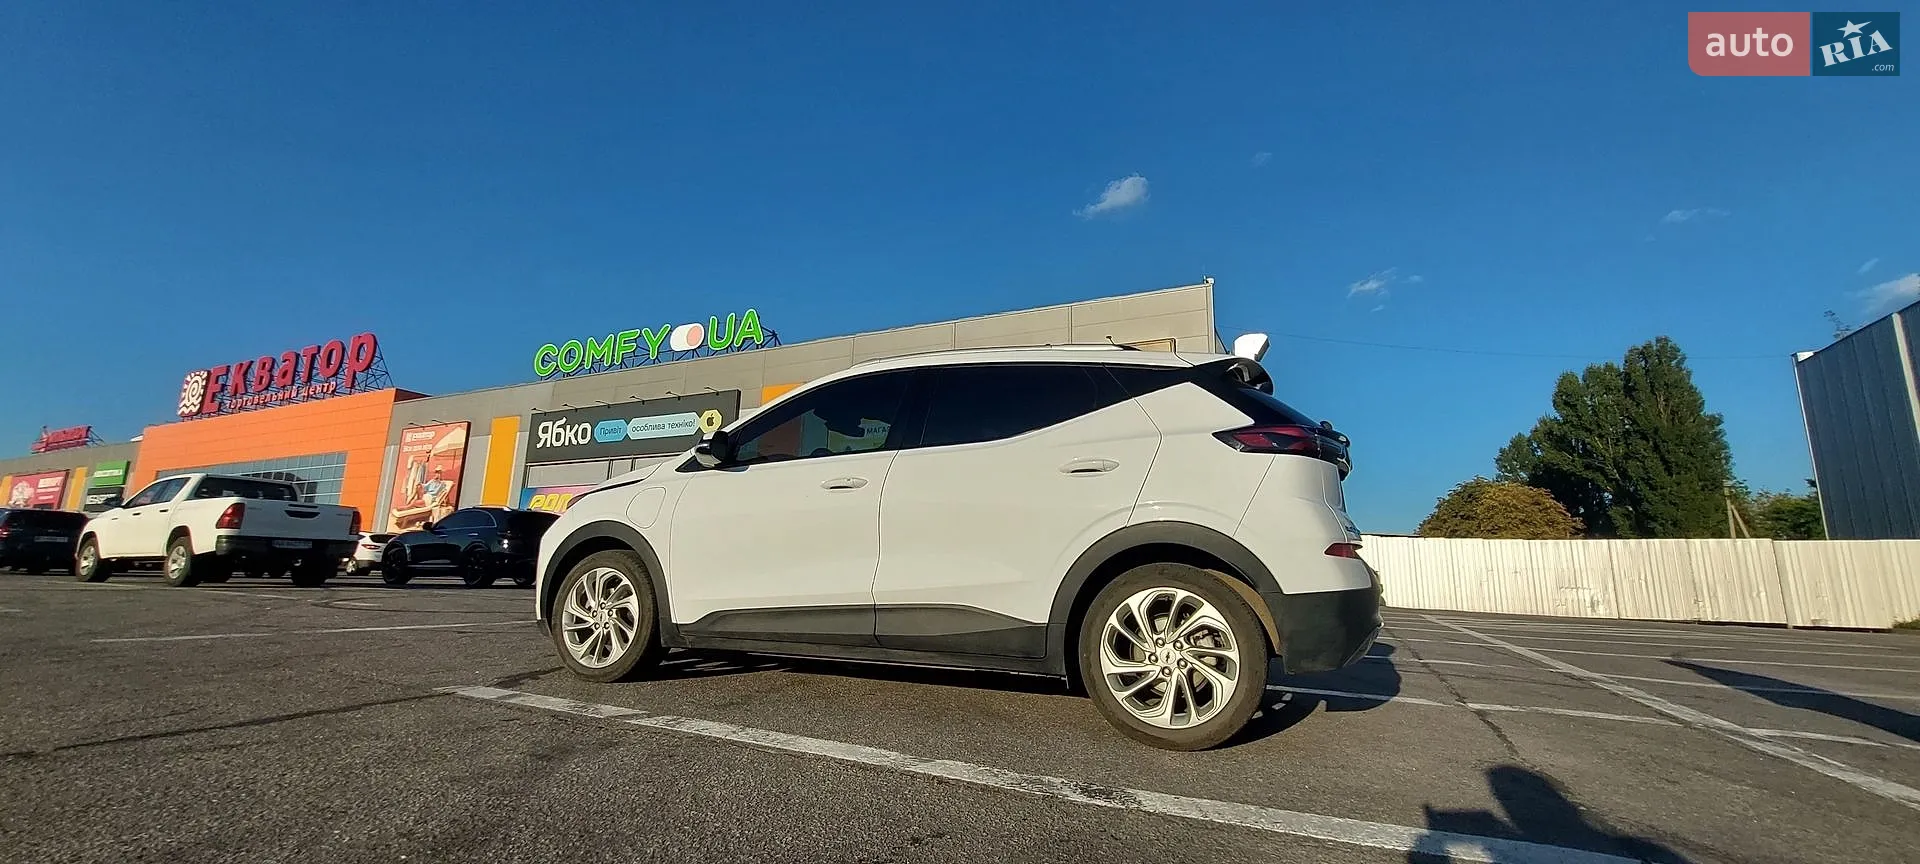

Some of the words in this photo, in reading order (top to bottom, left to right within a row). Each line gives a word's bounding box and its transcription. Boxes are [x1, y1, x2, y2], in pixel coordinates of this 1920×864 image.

[534, 324, 671, 377] COMFY
[707, 308, 764, 350] UA
[226, 385, 298, 409] торговельний
[302, 382, 337, 401] центр
[536, 416, 592, 449] Ябко
[599, 426, 622, 436] Привіт
[631, 422, 666, 433] особлива
